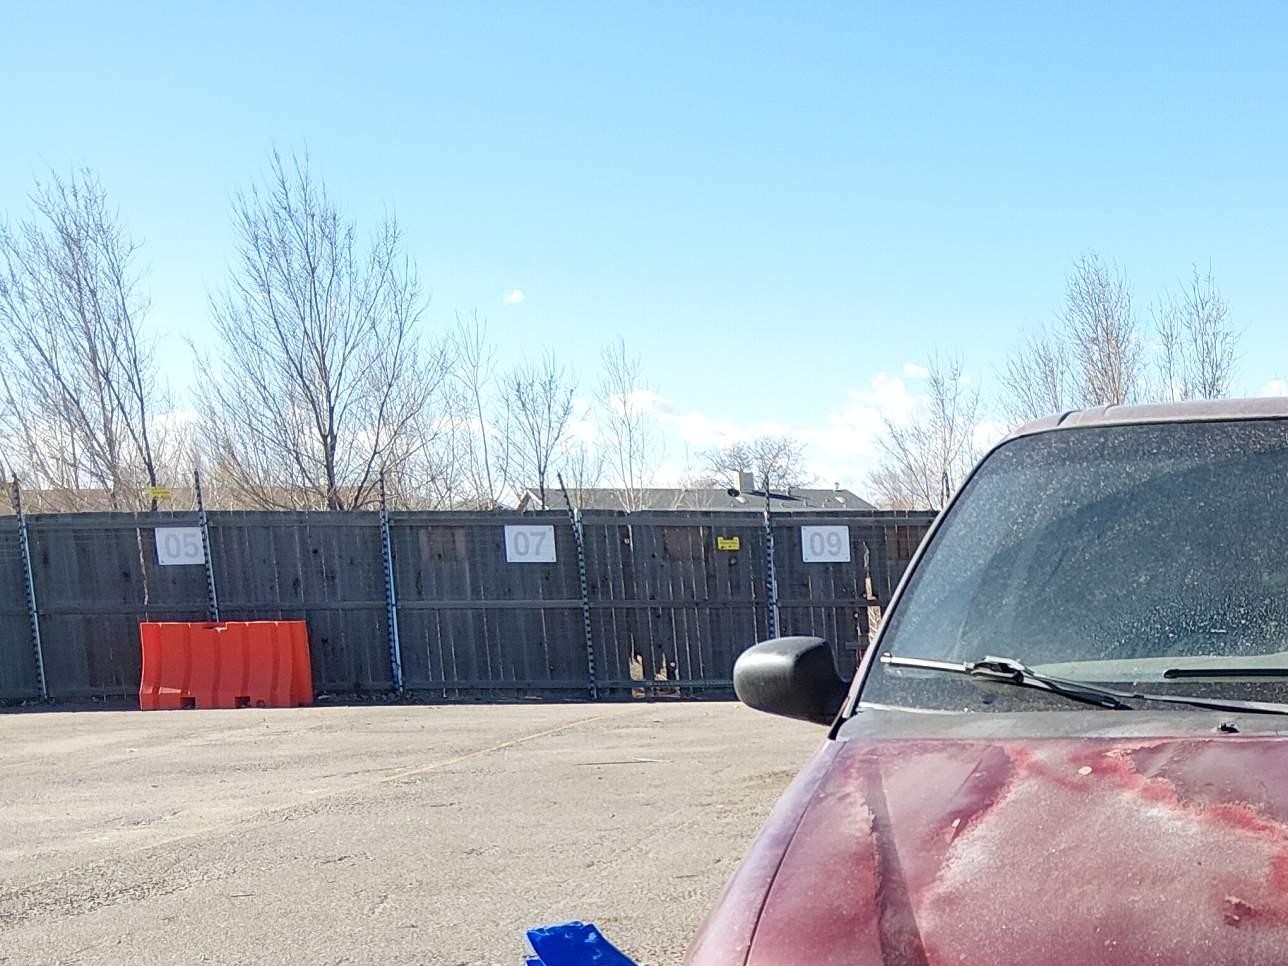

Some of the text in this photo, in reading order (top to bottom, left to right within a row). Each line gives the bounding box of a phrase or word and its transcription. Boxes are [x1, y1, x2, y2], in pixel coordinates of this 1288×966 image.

[165, 533, 199, 559] 05
[513, 531, 547, 556] 07
[809, 531, 842, 557] 09
